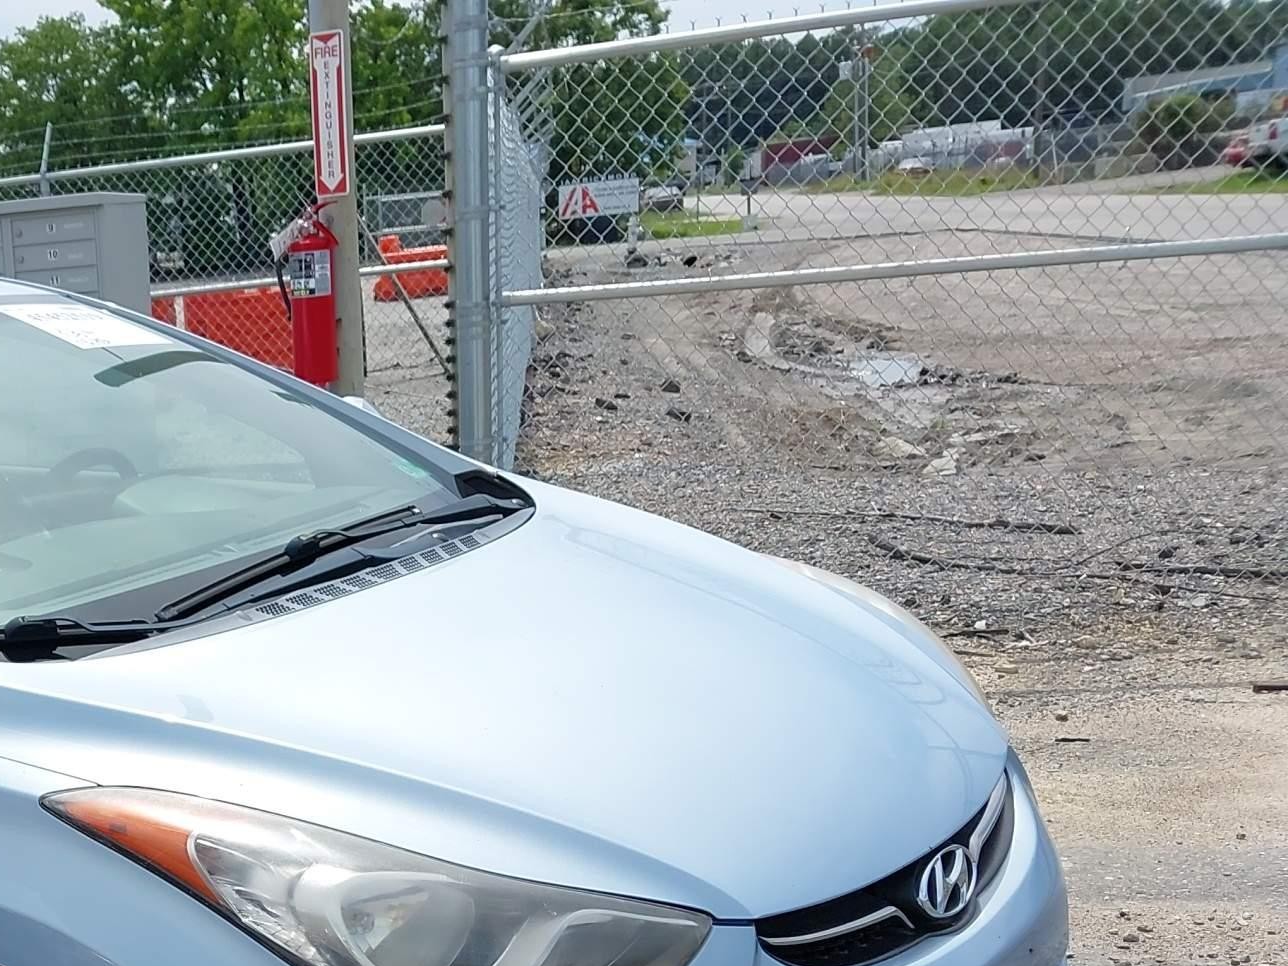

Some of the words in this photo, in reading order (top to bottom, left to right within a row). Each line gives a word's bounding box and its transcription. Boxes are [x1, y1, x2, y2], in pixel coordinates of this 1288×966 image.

[314, 44, 339, 58] FIRE
[324, 61, 335, 179] EXTINGUISHER
[48, 250, 58, 259] 10
